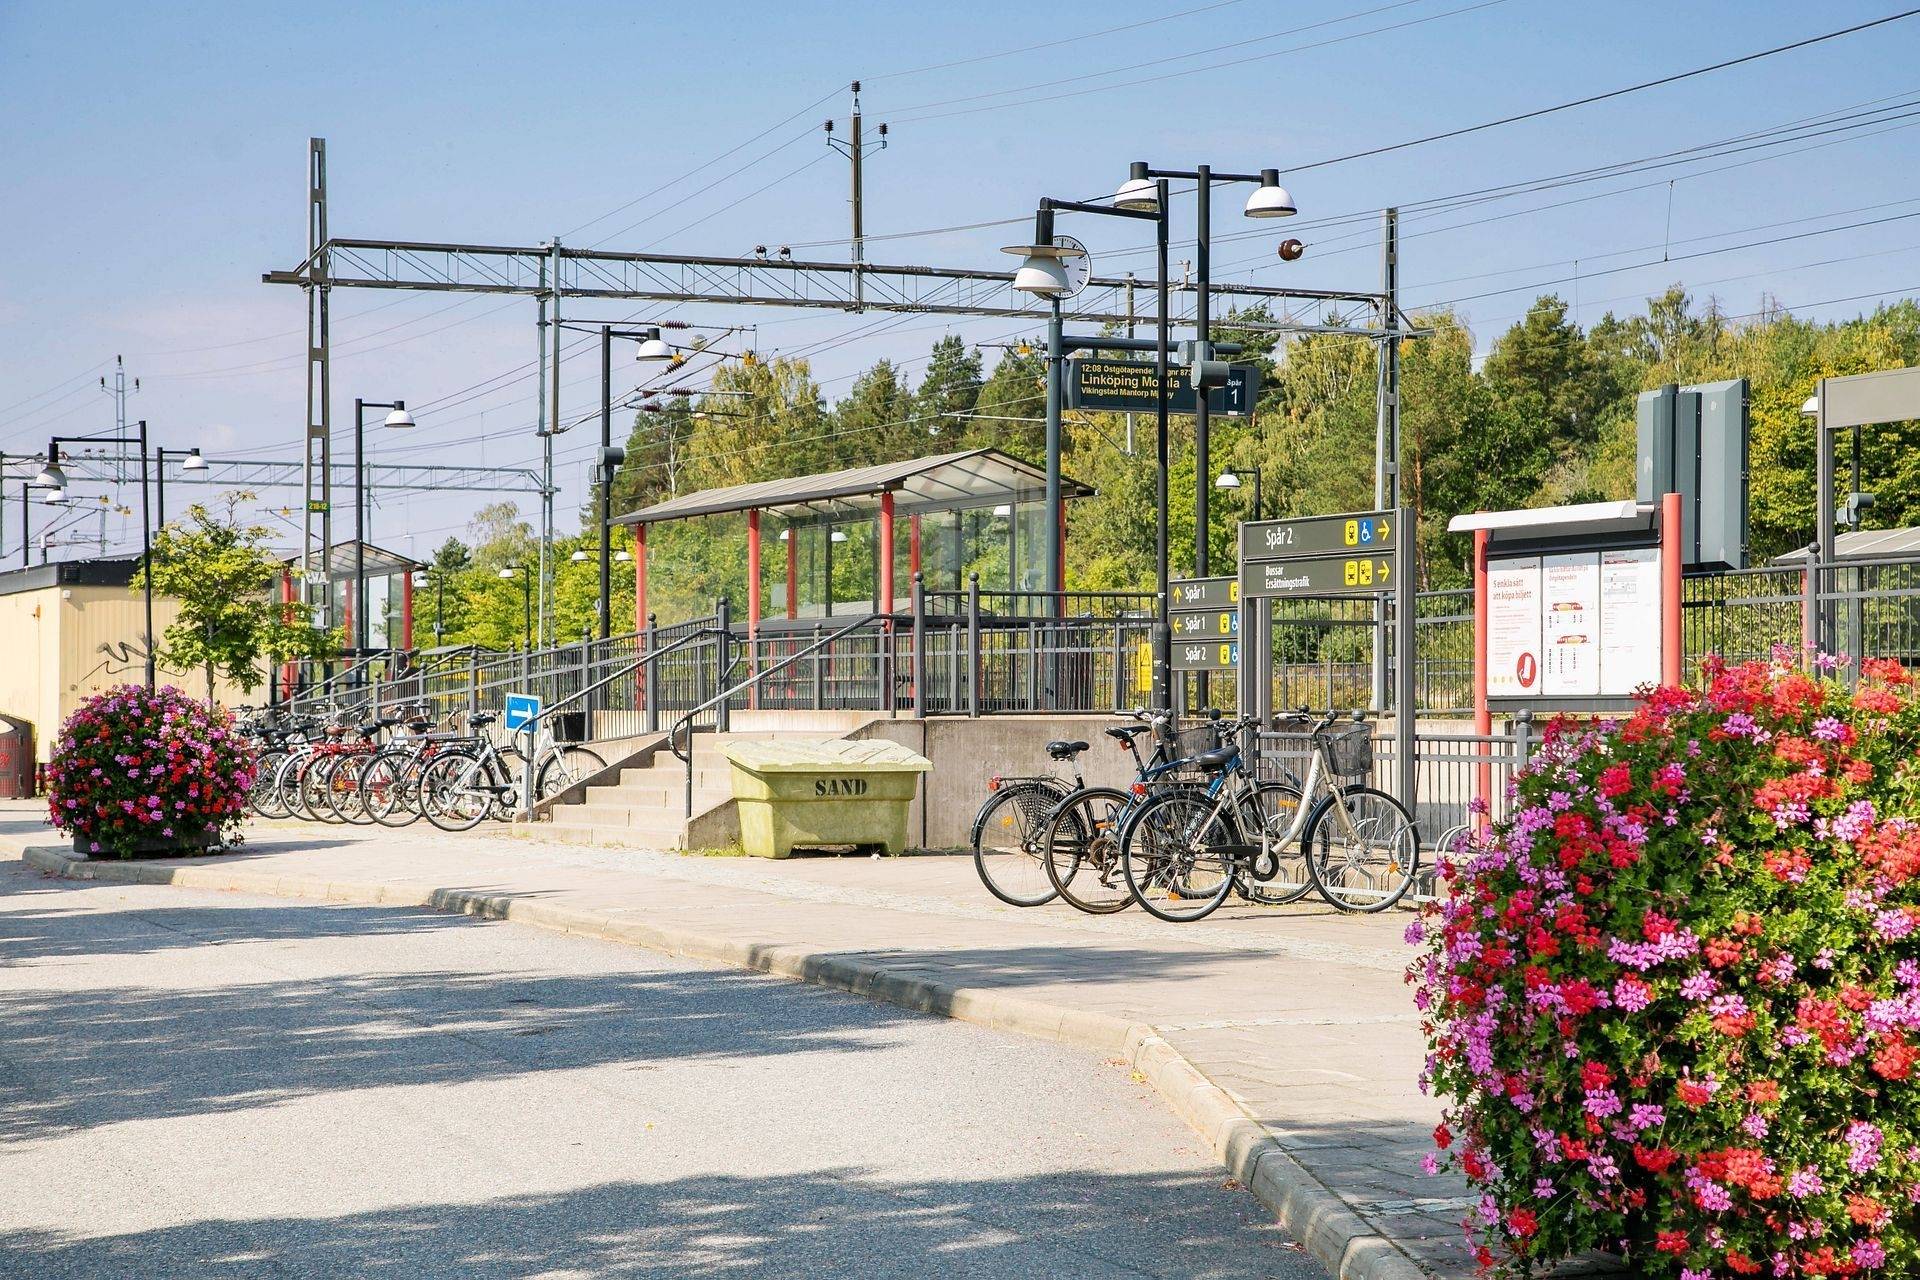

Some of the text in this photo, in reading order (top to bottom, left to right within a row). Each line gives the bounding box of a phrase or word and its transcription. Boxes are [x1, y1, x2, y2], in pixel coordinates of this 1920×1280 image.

[1081, 373, 1180, 389] Linköping Mola
[1081, 387, 1119, 397] Vikingstad
[1120, 388, 1149, 399] Mantorp
[1230, 388, 1238, 405] 1
[1265, 527, 1293, 550] Spår 2
[1265, 565, 1284, 577] Bussar
[1265, 575, 1310, 591] Ersättningstrafik
[1185, 584, 1206, 604] Spår 1
[1185, 614, 1206, 634] Spår 1
[1185, 645, 1207, 664] Spår 2
[815, 779, 868, 796] SAND
